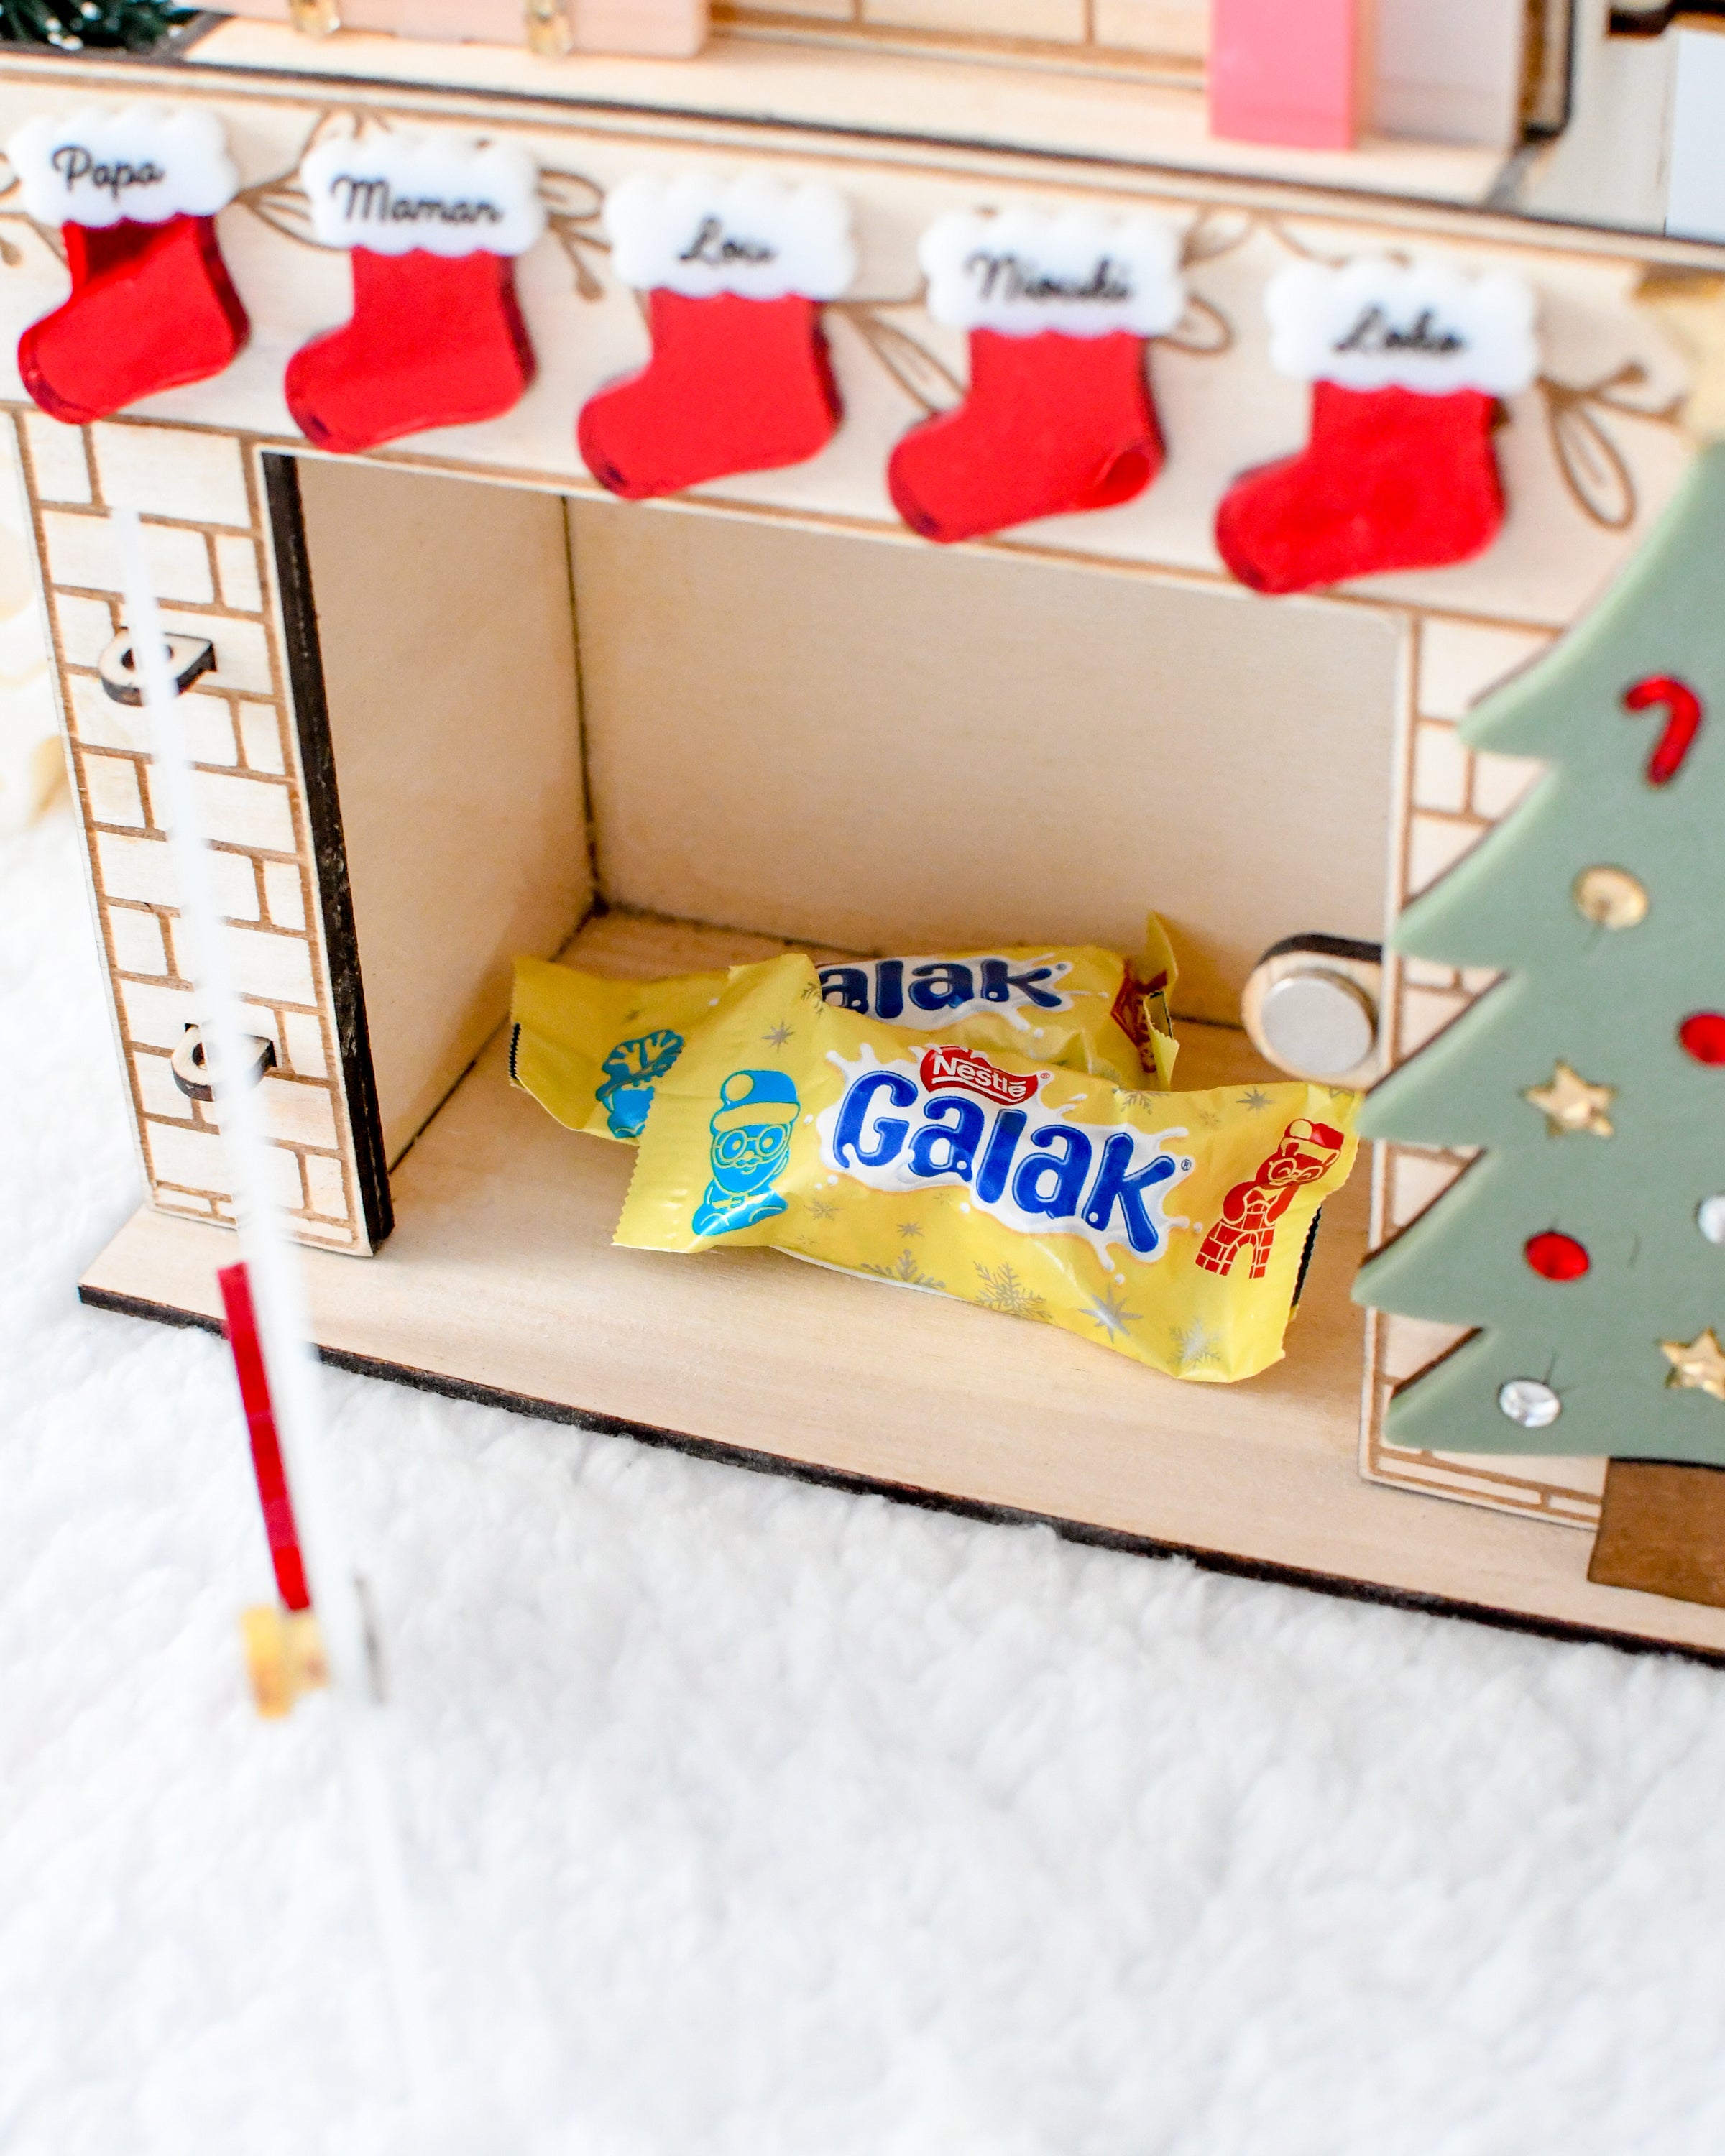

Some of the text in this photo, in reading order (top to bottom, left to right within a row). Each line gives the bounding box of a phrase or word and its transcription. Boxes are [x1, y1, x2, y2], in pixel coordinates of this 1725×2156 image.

[51, 144, 167, 203] Papa
[329, 175, 505, 224] Maman
[819, 959, 1062, 1019] alak
[932, 1054, 1028, 1098] Nestlé
[832, 1070, 1177, 1253] Galak
